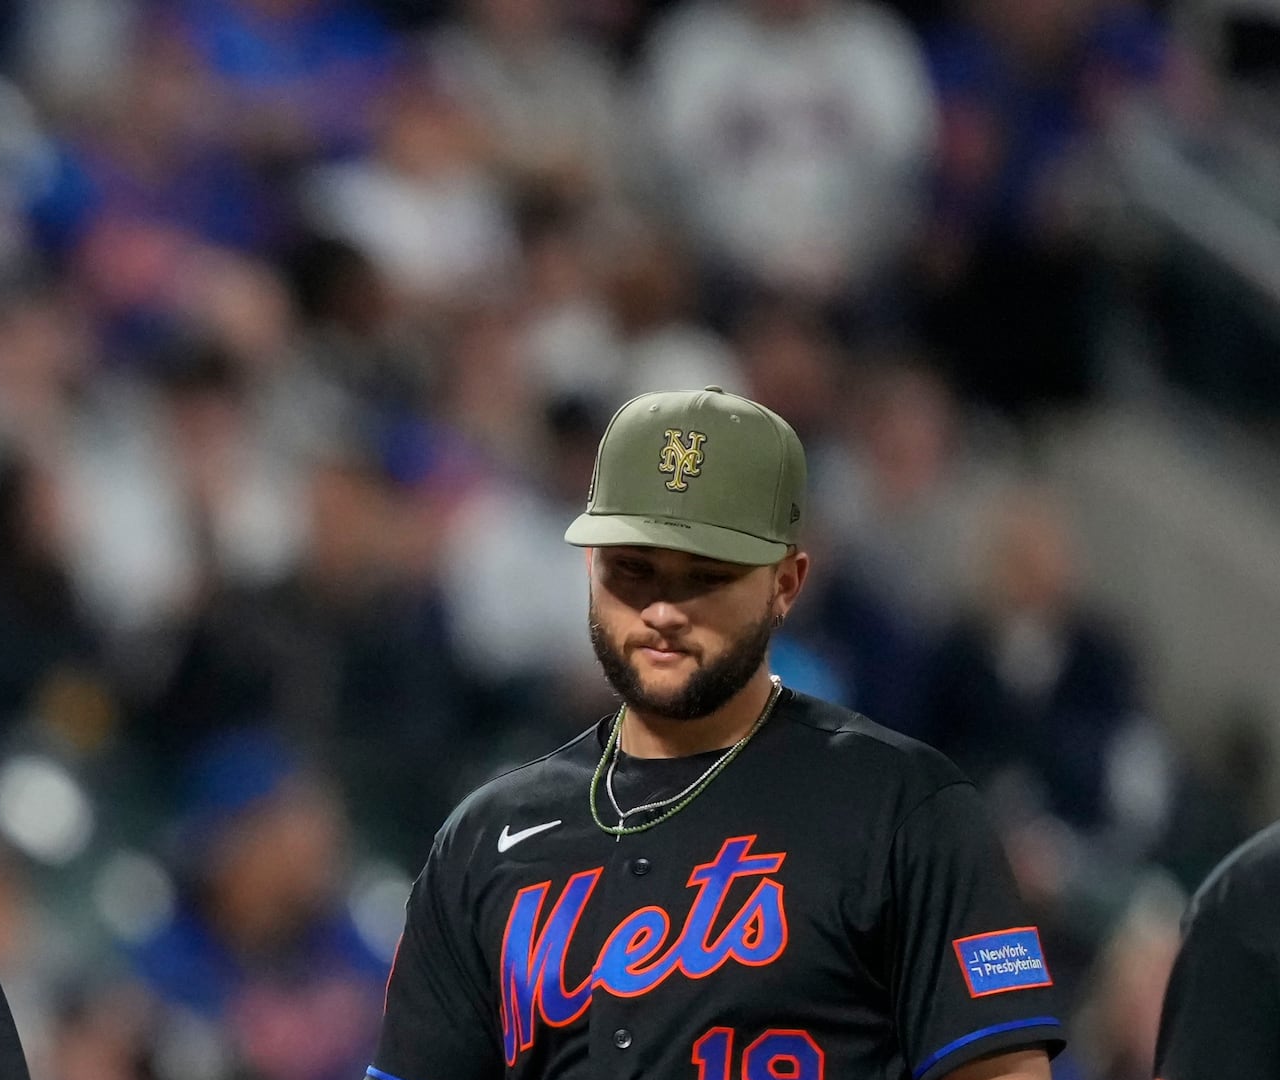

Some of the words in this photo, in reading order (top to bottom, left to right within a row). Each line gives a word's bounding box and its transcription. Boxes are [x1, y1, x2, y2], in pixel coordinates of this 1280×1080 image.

[500, 834, 788, 1068] Mets
[979, 943, 1028, 962] NewYork-
[983, 956, 1042, 976] Presbyterian
